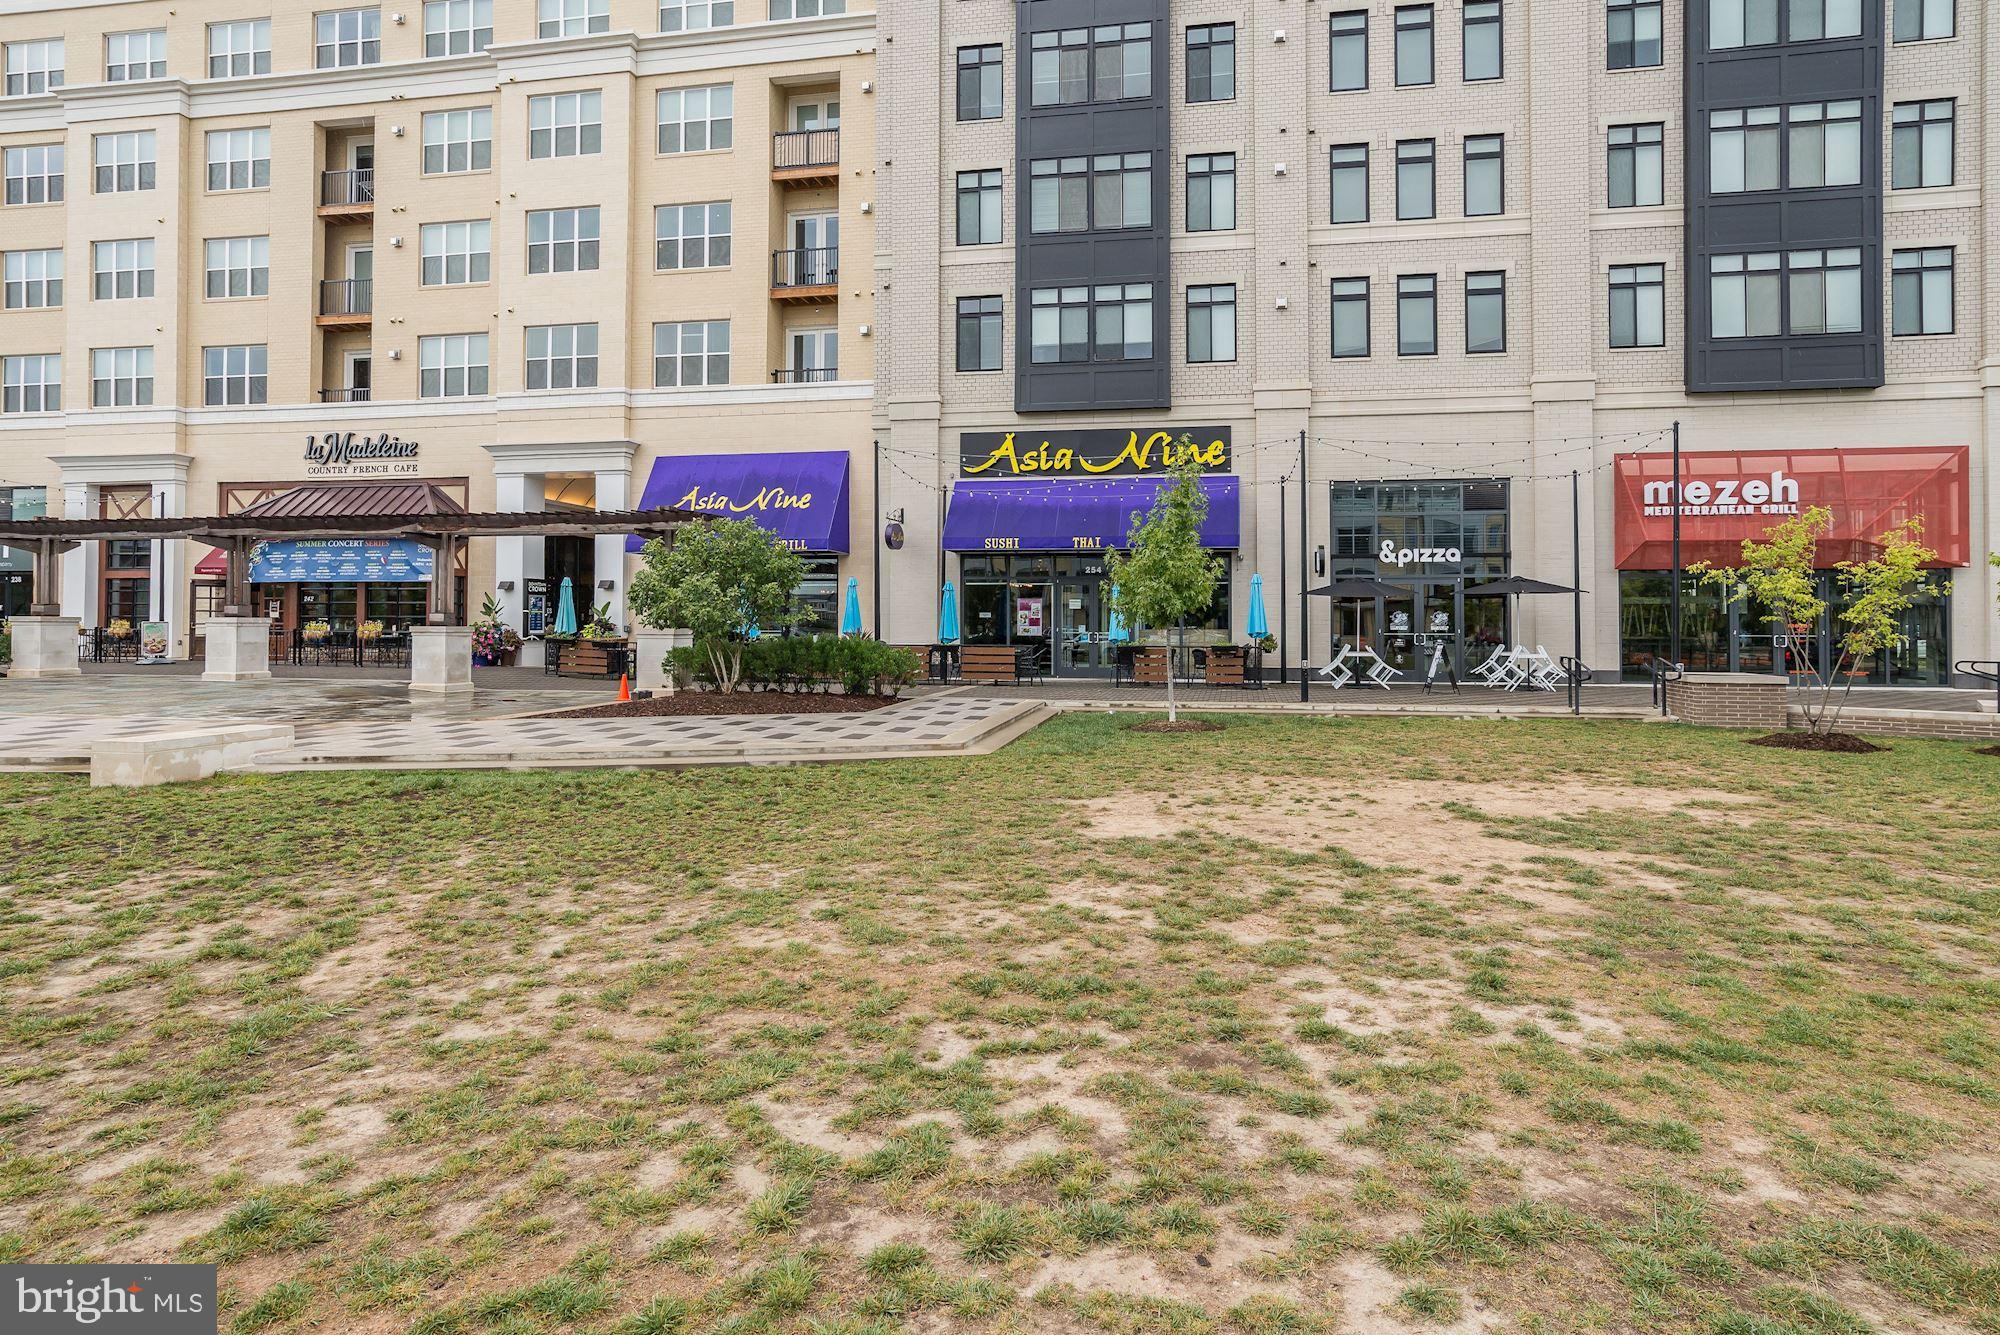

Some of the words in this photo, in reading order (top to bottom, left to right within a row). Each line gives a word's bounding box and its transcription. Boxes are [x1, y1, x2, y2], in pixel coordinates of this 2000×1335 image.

[315, 432, 419, 465] Madeleine
[963, 432, 1074, 474] Asia
[1078, 430, 1226, 474] Nine
[307, 466, 349, 475] COUNTRY
[352, 465, 389, 474] FRENCH
[393, 464, 418, 473] CAFE
[1643, 470, 1799, 505] mezeh
[673, 486, 729, 511] Asia
[729, 486, 812, 512] Nine
[1760, 504, 1798, 514] GRILL
[295, 540, 327, 548] SUMMER
[984, 537, 1020, 549] SUSHI
[1072, 536, 1101, 548] THAI
[1379, 540, 1461, 567] &pizza
[1085, 566, 1102, 574] 254
